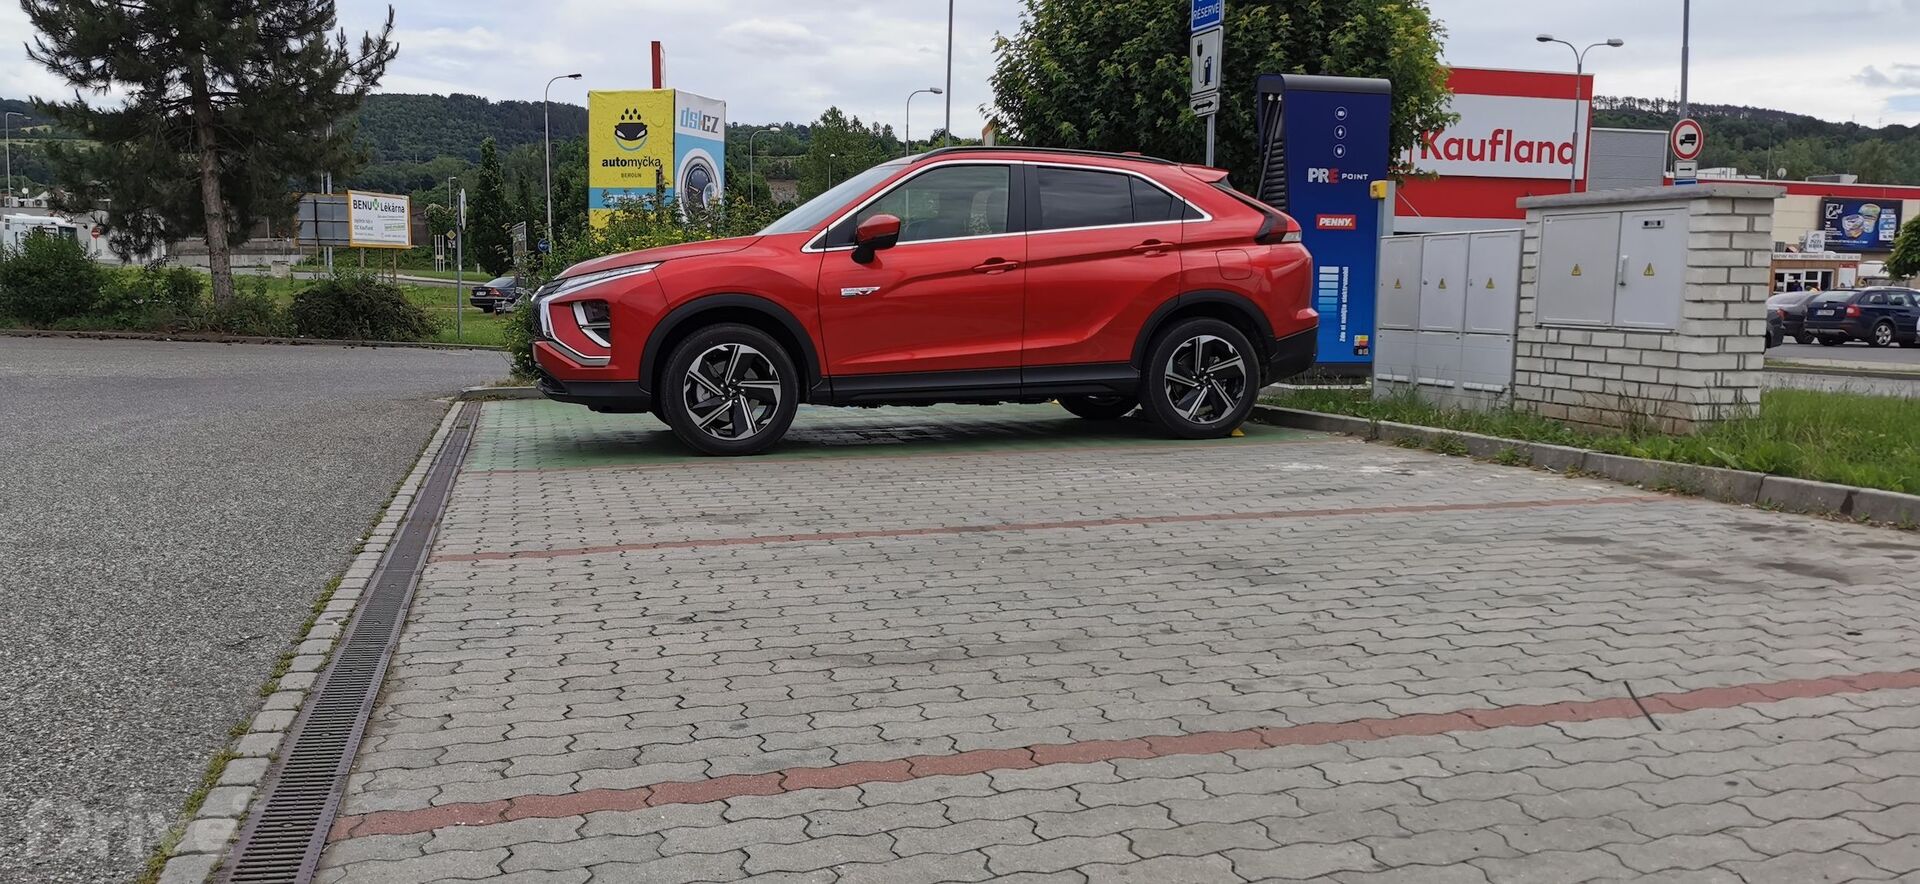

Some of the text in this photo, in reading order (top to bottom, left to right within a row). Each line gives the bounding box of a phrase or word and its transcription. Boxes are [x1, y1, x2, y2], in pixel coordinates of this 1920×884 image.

[1420, 128, 1575, 165] Kaufland
[602, 156, 661, 169] automyčka
[1307, 167, 1369, 184] PRE POINT
[353, 200, 405, 213] BENU Lékárna
